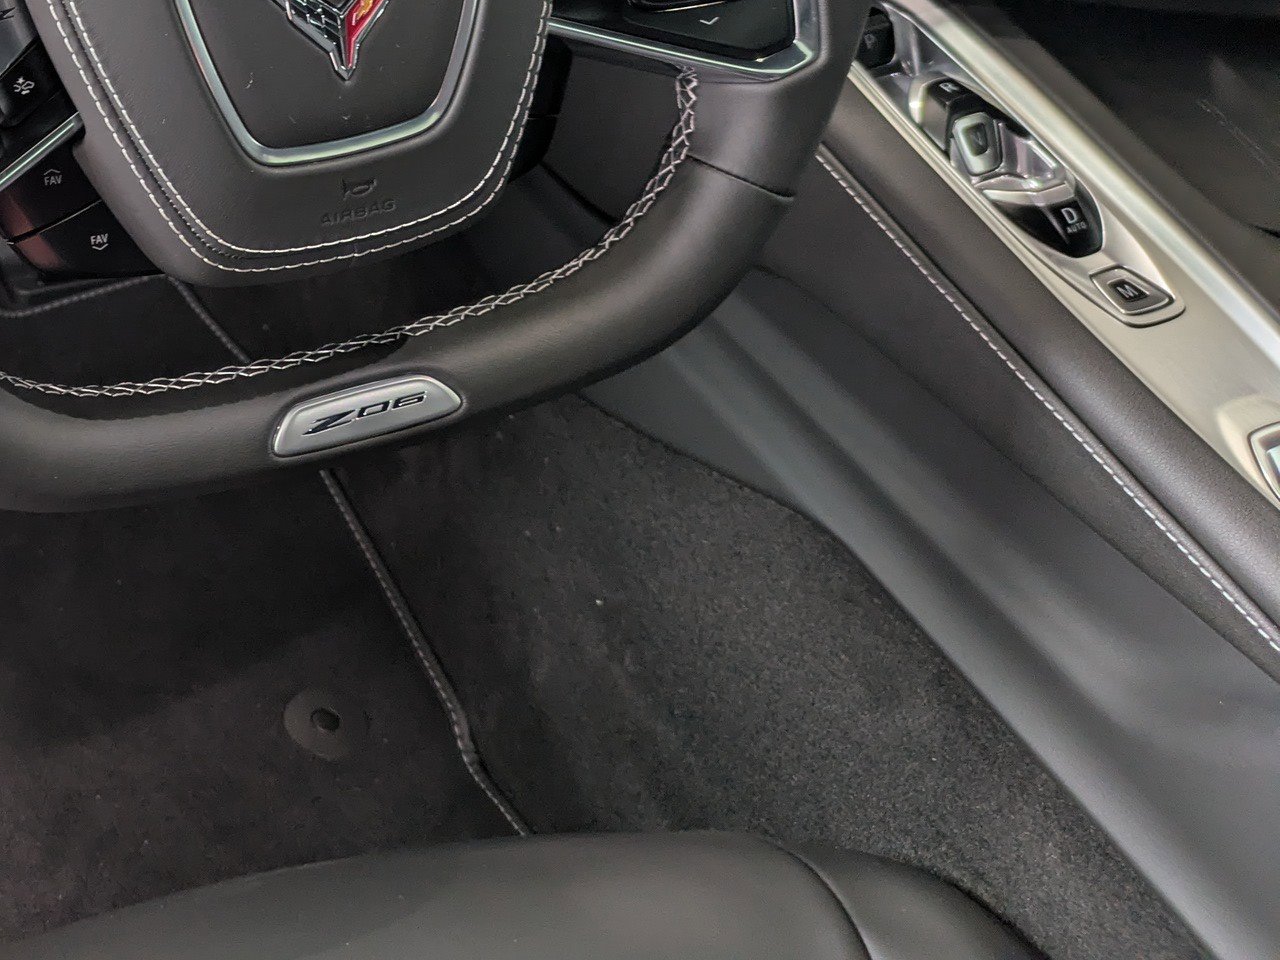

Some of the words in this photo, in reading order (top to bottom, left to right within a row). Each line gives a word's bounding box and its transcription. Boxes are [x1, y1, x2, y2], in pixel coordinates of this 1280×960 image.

[939, 81, 960, 94] R
[43, 174, 63, 186] FAV
[320, 199, 397, 227] AIRBAG
[1060, 207, 1078, 225] D
[1066, 221, 1088, 234] AUTO
[89, 233, 109, 246] FAV
[1115, 284, 1139, 299] M
[300, 390, 428, 436] Z06
